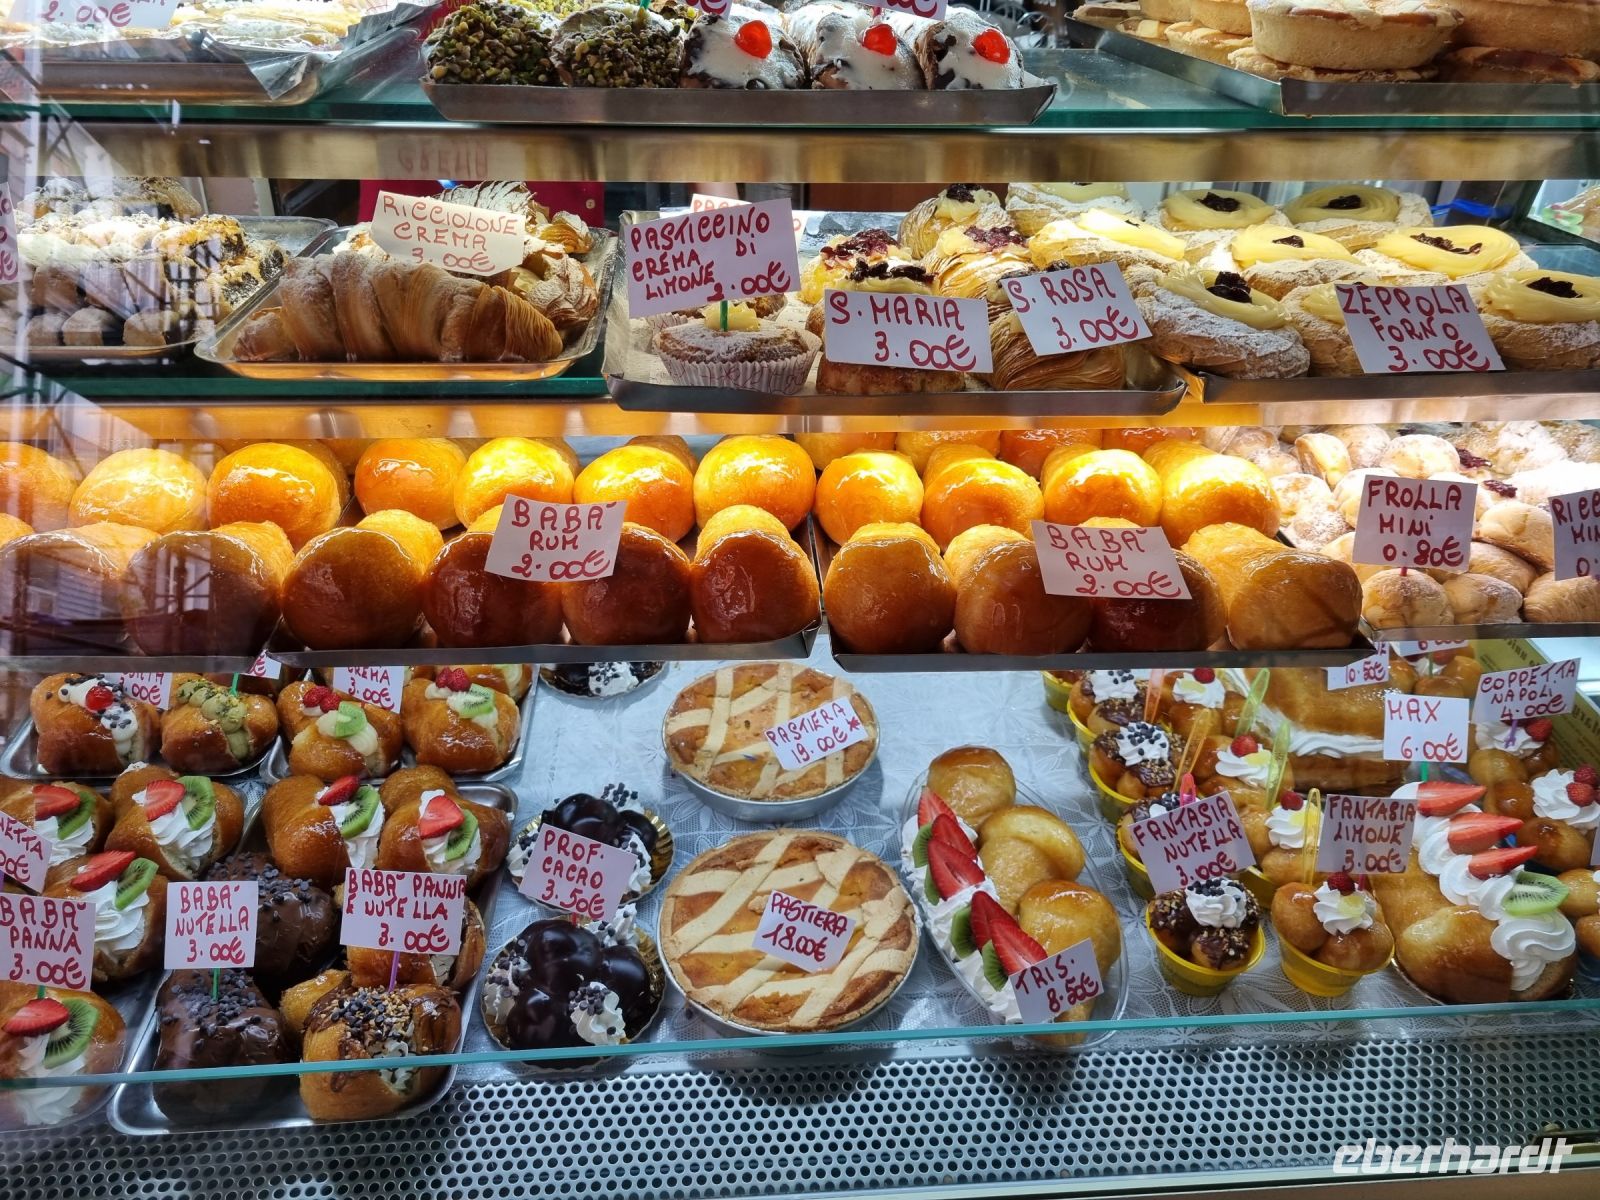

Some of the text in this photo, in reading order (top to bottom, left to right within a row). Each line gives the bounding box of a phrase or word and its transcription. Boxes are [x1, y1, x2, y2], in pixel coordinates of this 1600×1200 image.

[383, 195, 518, 235] RICCIOLONE
[630, 206, 770, 252] PASTICCINO
[393, 221, 487, 251] CREMA
[632, 248, 701, 282] CREMA
[645, 260, 715, 300] LIMONE
[1040, 267, 1116, 306] ROSA
[1336, 282, 1470, 317] ZEPPOLA
[869, 295, 965, 331] MARIA
[1369, 315, 1460, 342] FORNO
[1367, 479, 1462, 511] FROLLA
[529, 530, 579, 551] RUM
[1382, 535, 1465, 567] 0.80€
[1065, 551, 1129, 572] RUM
[766, 702, 847, 747] PASTIERA
[1387, 698, 1441, 724] MAX
[1400, 732, 1463, 762] 6.00€
[1133, 796, 1233, 847] FANTASIA
[1328, 796, 1417, 822] FANTASIA
[544, 829, 605, 865] PROF.
[1163, 819, 1243, 863] NUTELLA
[1333, 821, 1406, 845] LIMONE
[412, 874, 466, 900] PANNA
[542, 856, 604, 890] CACAO
[364, 895, 449, 921] NUTELLA
[541, 879, 605, 919] 3.50€
[771, 892, 848, 938] PASTIERA
[175, 905, 249, 937] NUTELLA
[378, 922, 450, 953] 3.00€
[9, 925, 82, 955] PANNA
[186, 935, 246, 965] 3.00€
[762, 922, 829, 962] 18.00€
[9, 953, 87, 990] 3.00€
